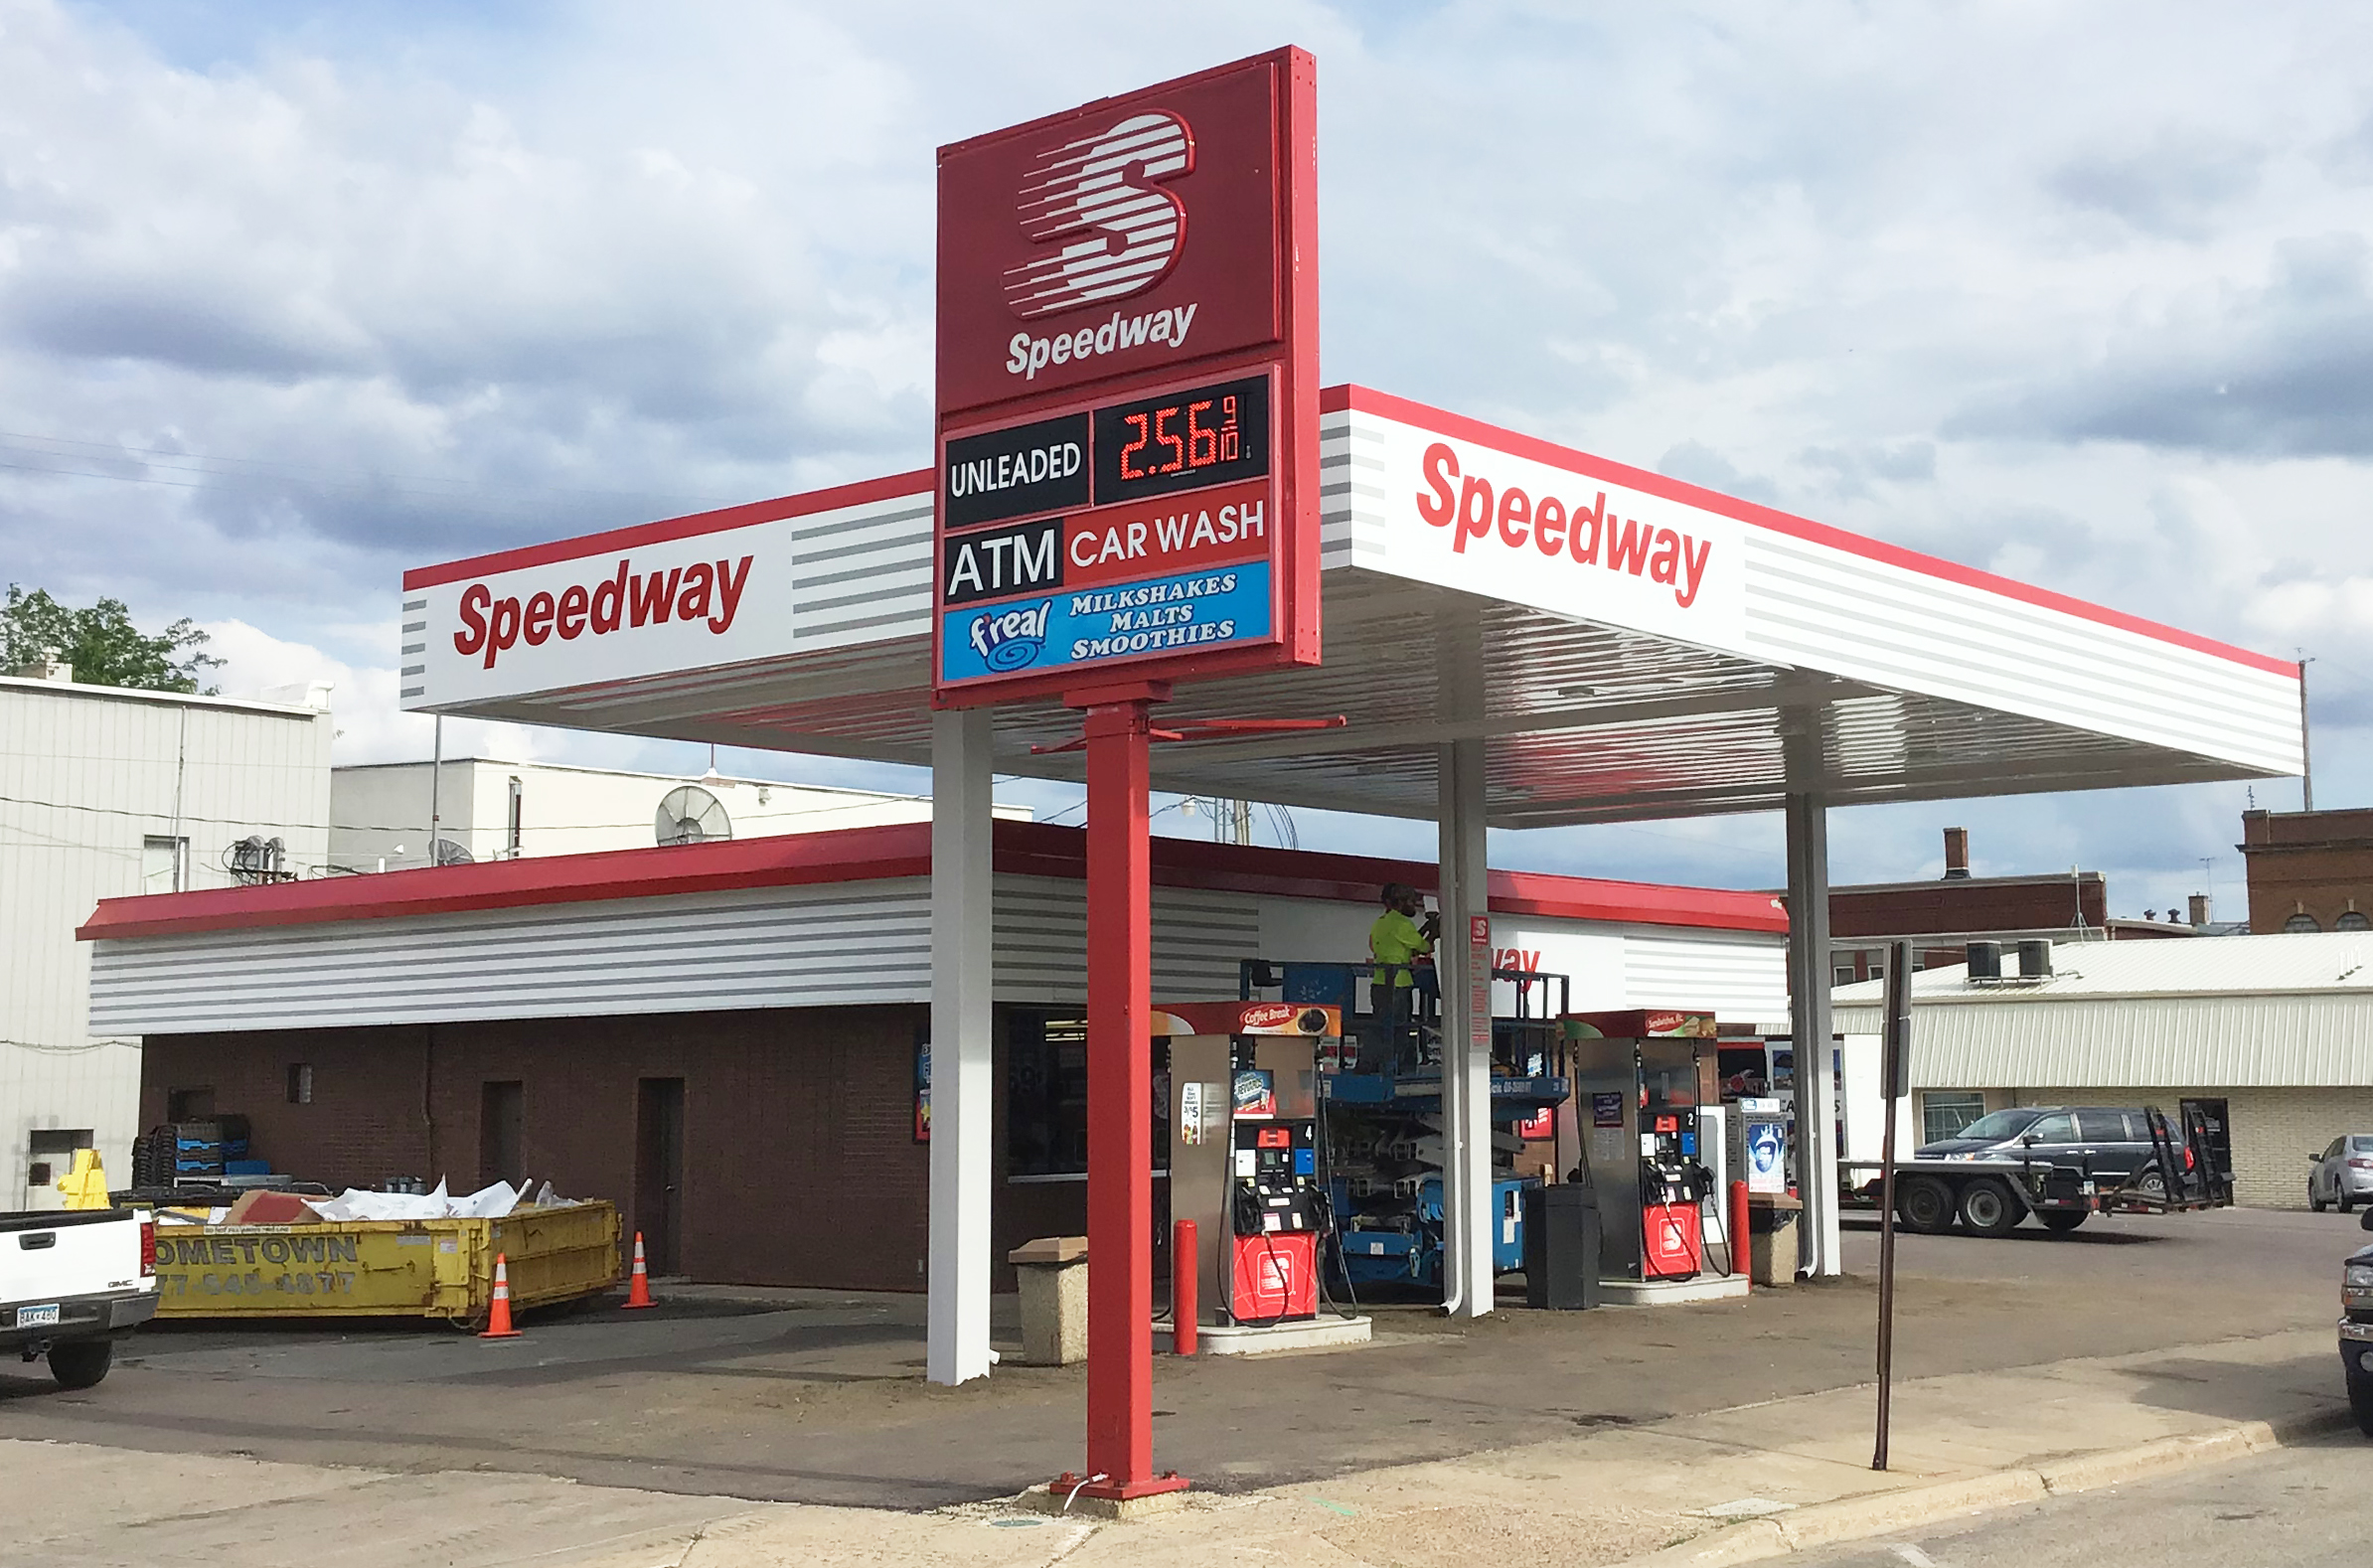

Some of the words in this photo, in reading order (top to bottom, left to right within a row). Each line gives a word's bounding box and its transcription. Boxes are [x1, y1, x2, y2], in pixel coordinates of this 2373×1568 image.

[1006, 302, 1197, 380] Speedway
[1120, 399, 1216, 481] 2.56
[951, 442, 1081, 497] UNLEADED
[1070, 522, 1148, 567] CAR
[1156, 500, 1264, 553] WASH
[1416, 442, 1712, 608] Speedway
[948, 529, 1055, 595] ATM
[452, 554, 754, 670] Speedway
[1068, 573, 1237, 618] MILKSHAKES
[1070, 620, 1235, 660] SMOOTHIES
[1109, 604, 1194, 633] MALTS
[1244, 1010, 1268, 1025] Coffee
[1269, 1005, 1291, 1020] Break
[1305, 1125, 1313, 1141] 4
[1687, 1113, 1694, 1126] 2
[156, 1235, 358, 1265] OMETOWN
[107, 1279, 133, 1288] GMC
